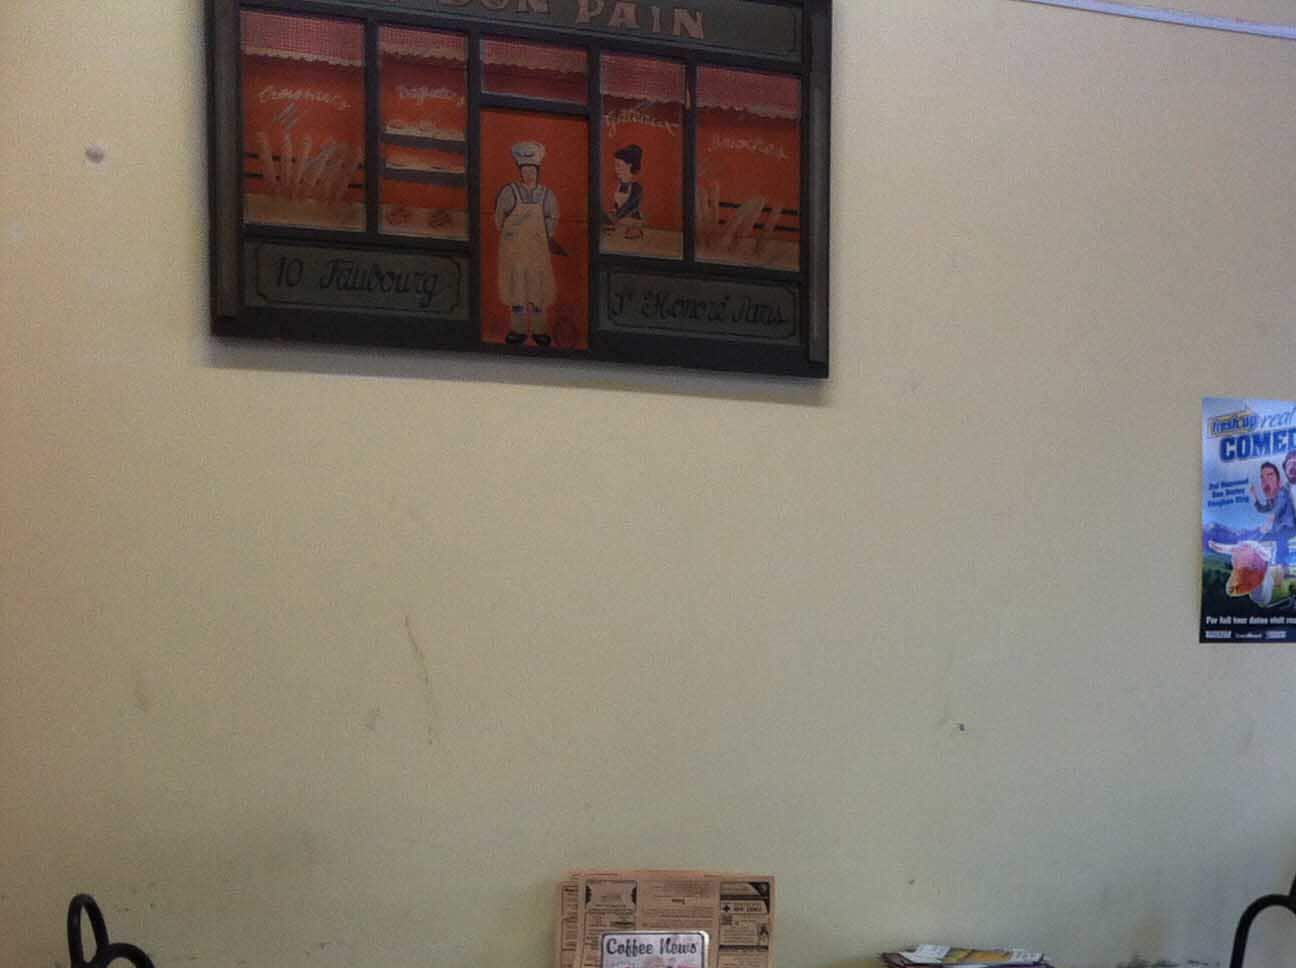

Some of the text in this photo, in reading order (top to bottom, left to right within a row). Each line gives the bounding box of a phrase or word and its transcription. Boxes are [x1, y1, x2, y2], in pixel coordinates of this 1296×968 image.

[576, 0, 704, 39] PAIN
[606, 937, 698, 957] Coffee News
